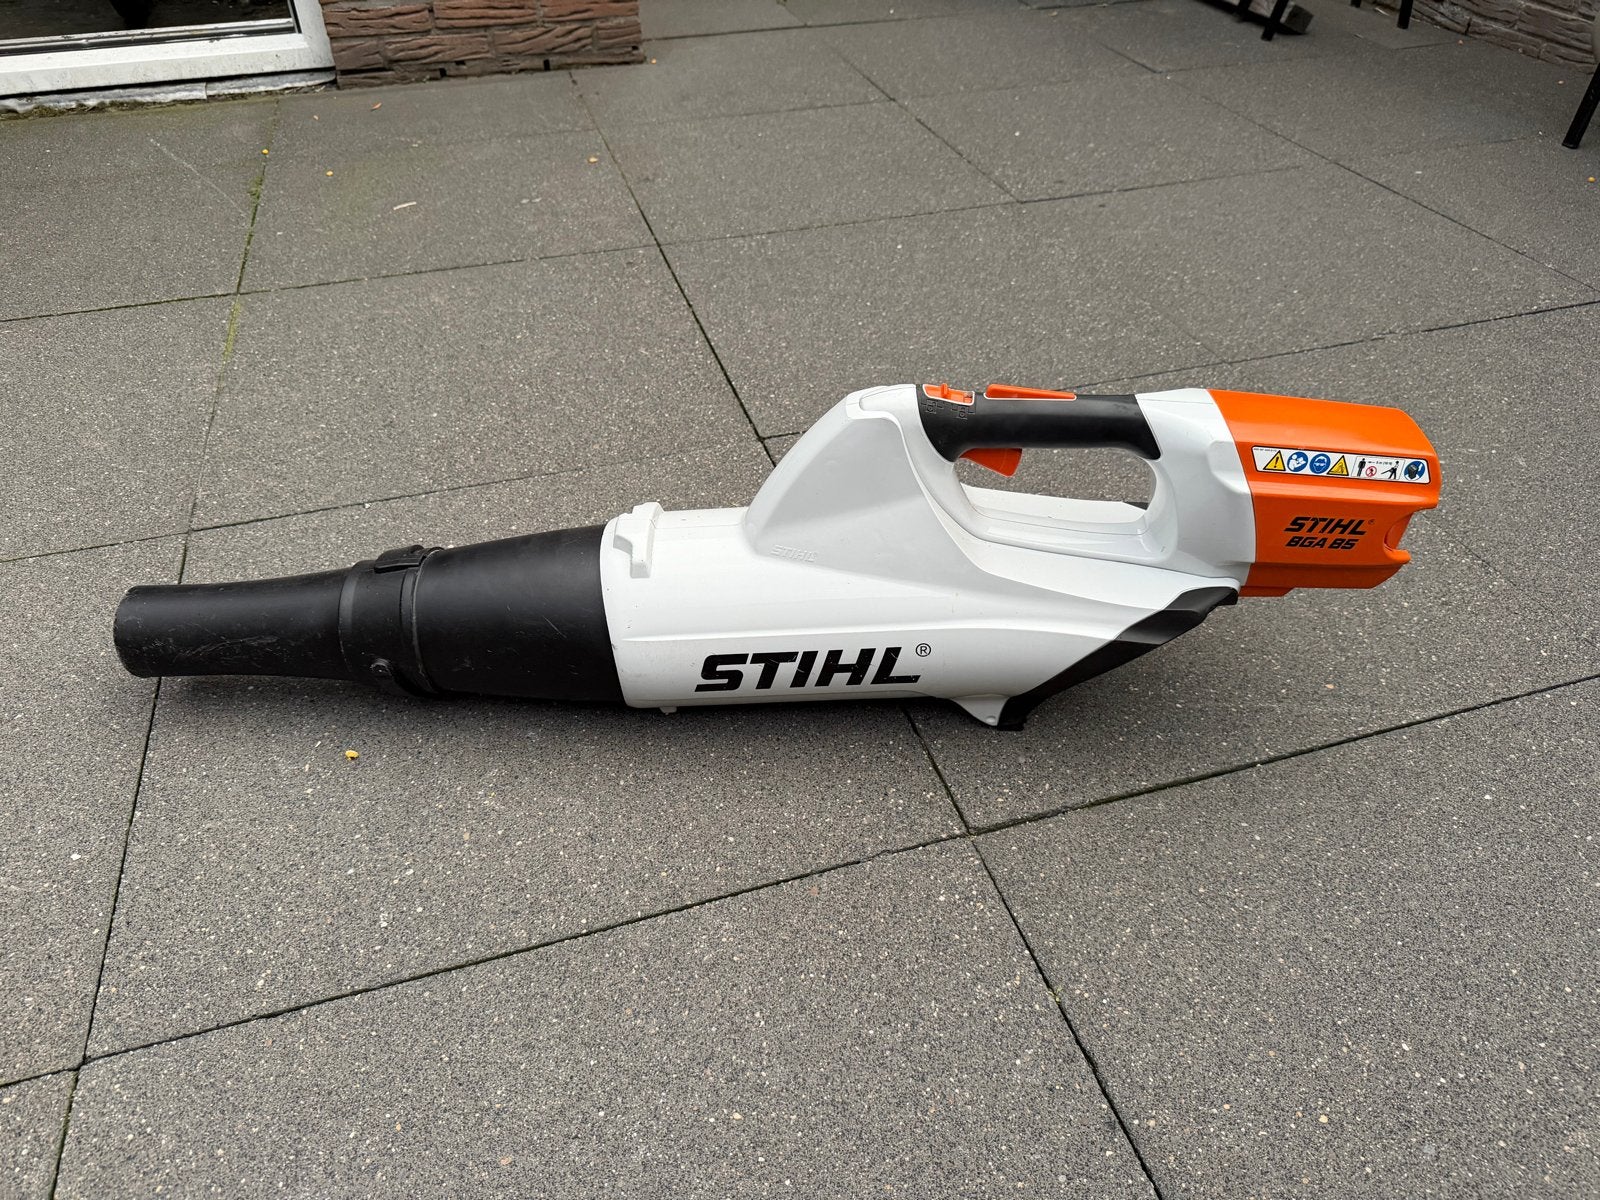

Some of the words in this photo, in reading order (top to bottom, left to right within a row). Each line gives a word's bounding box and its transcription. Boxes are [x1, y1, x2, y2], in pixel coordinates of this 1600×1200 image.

[1284, 516, 1367, 535] STIHL
[1285, 536, 1328, 548] BGA
[1327, 538, 1360, 550] 85
[770, 545, 817, 563] STIHL
[694, 647, 921, 692] STIHL
